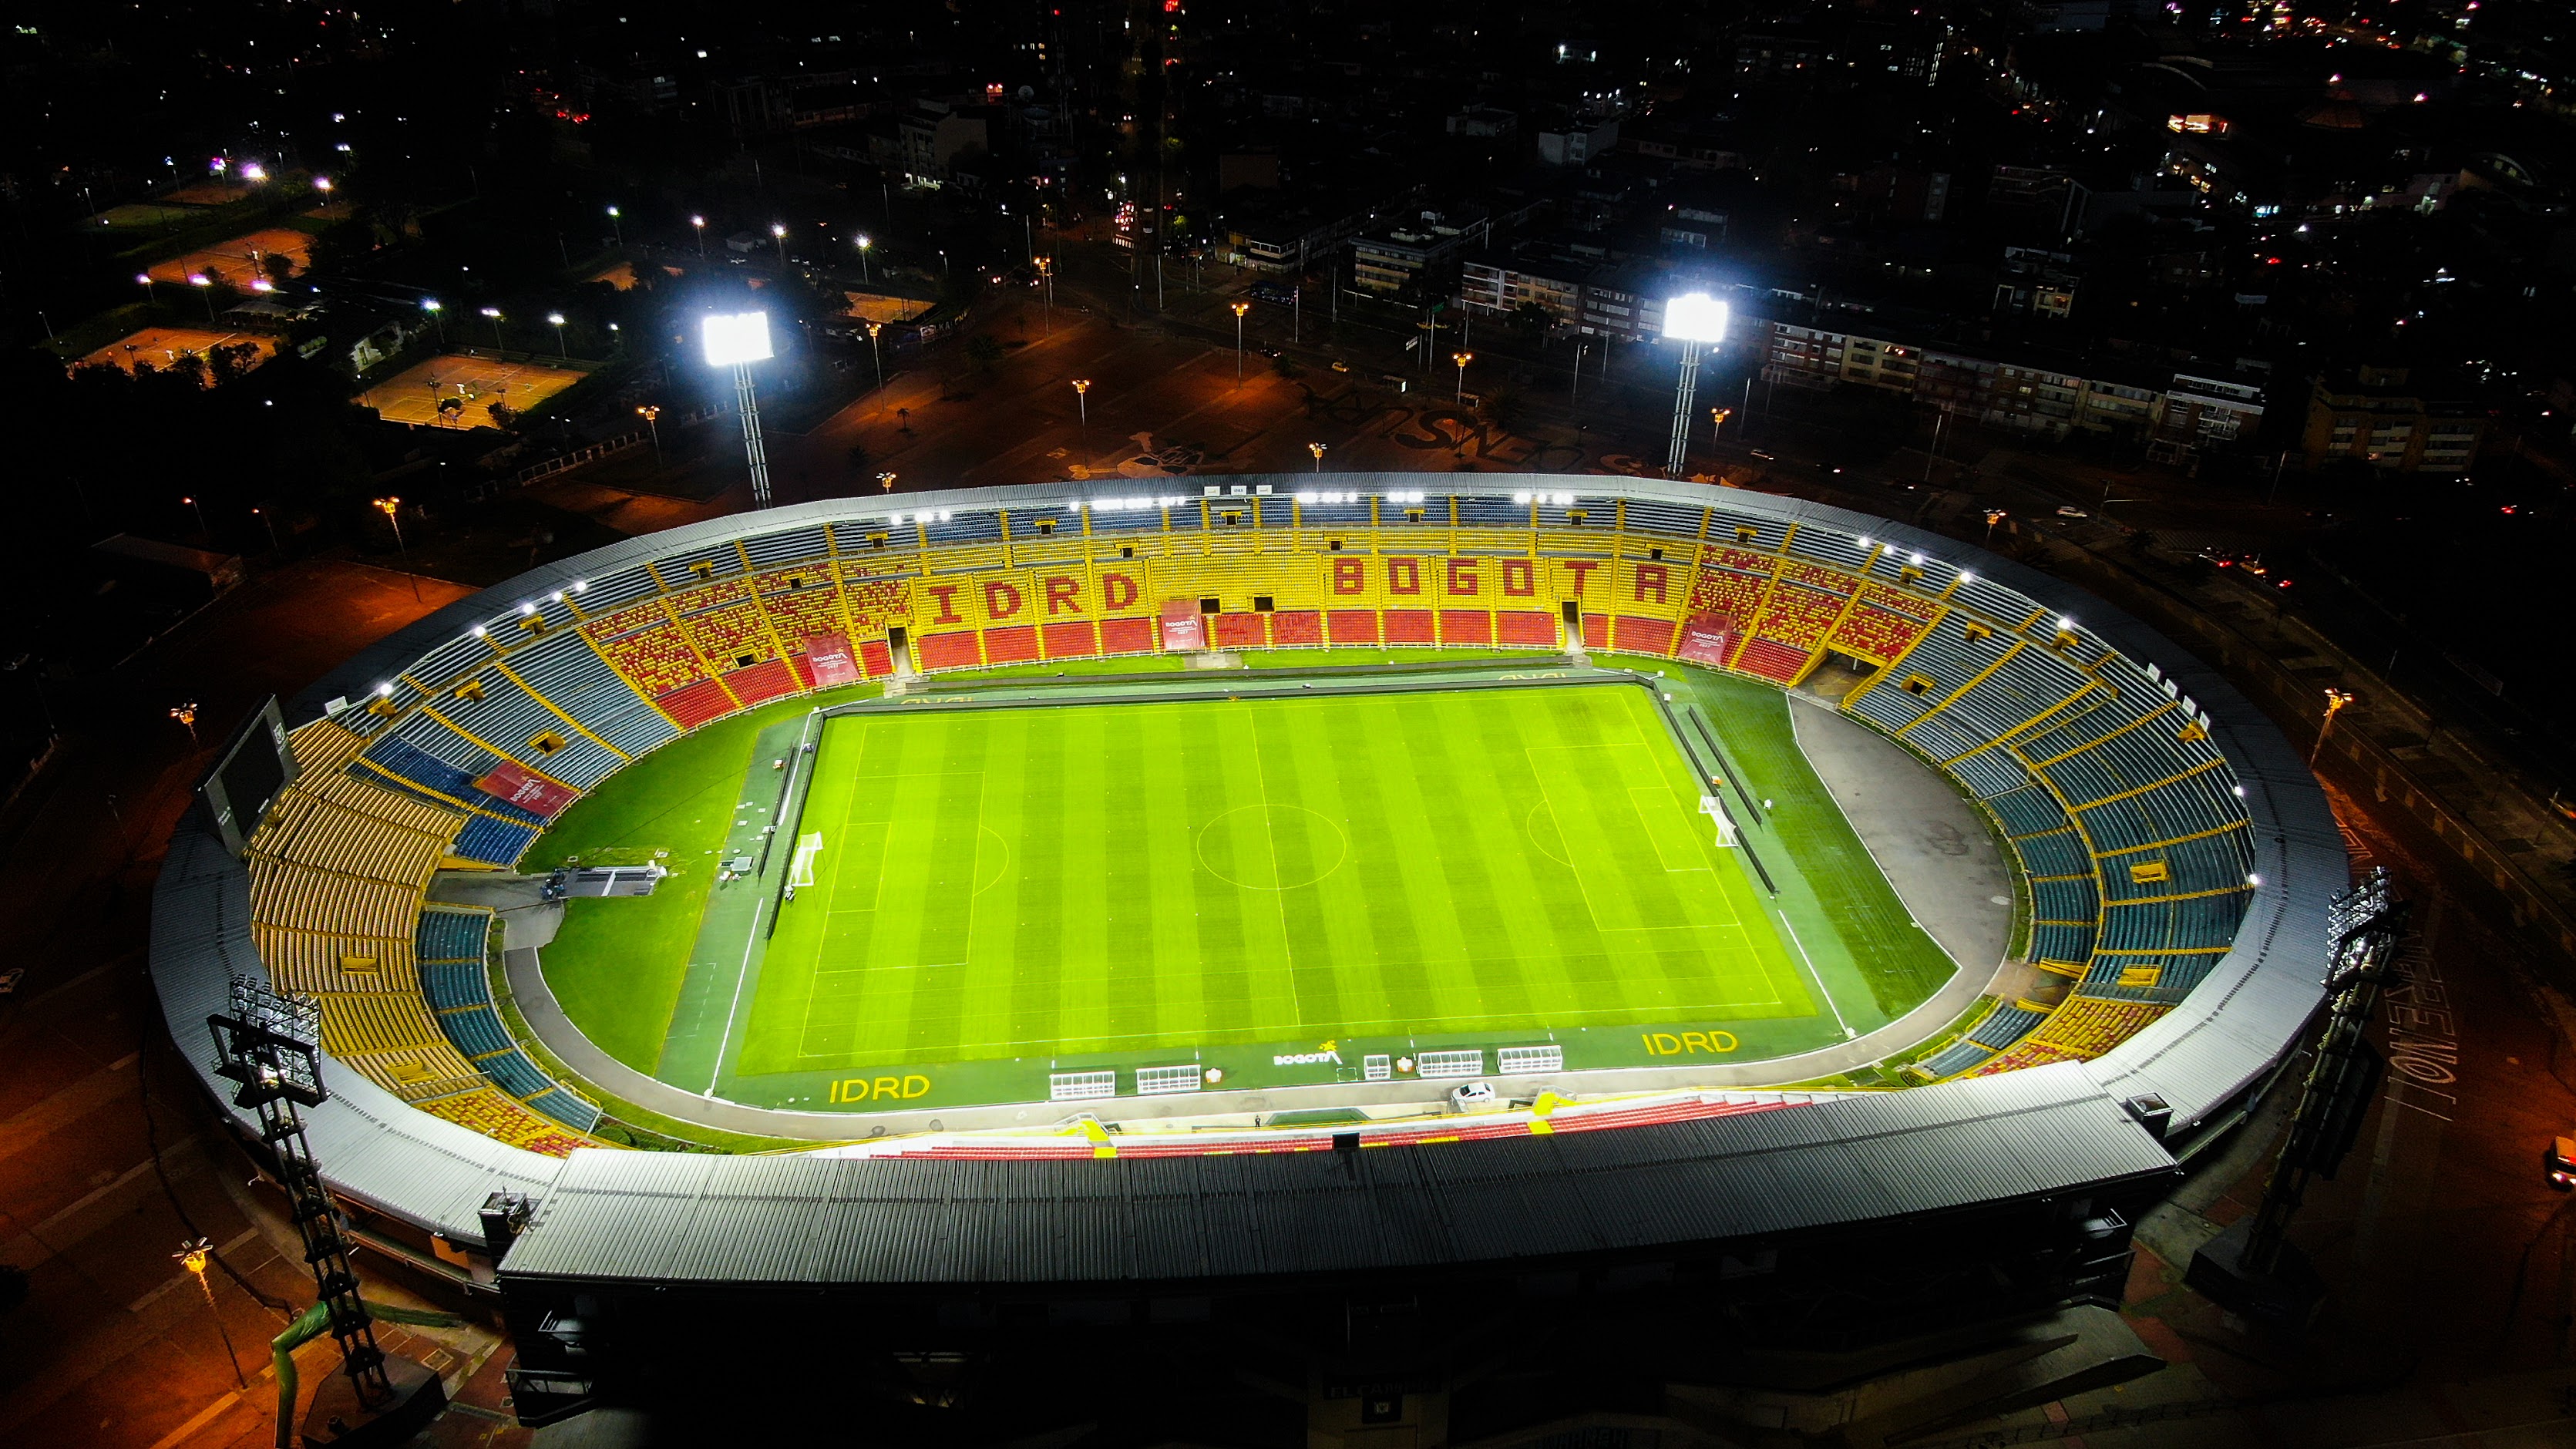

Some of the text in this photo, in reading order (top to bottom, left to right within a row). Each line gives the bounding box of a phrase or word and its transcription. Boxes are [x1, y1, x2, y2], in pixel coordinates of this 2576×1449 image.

[927, 557, 1668, 624] IDRD BOGOTA
[1642, 1030, 1739, 1056] IDRD
[829, 1074, 931, 1104] IDRD
